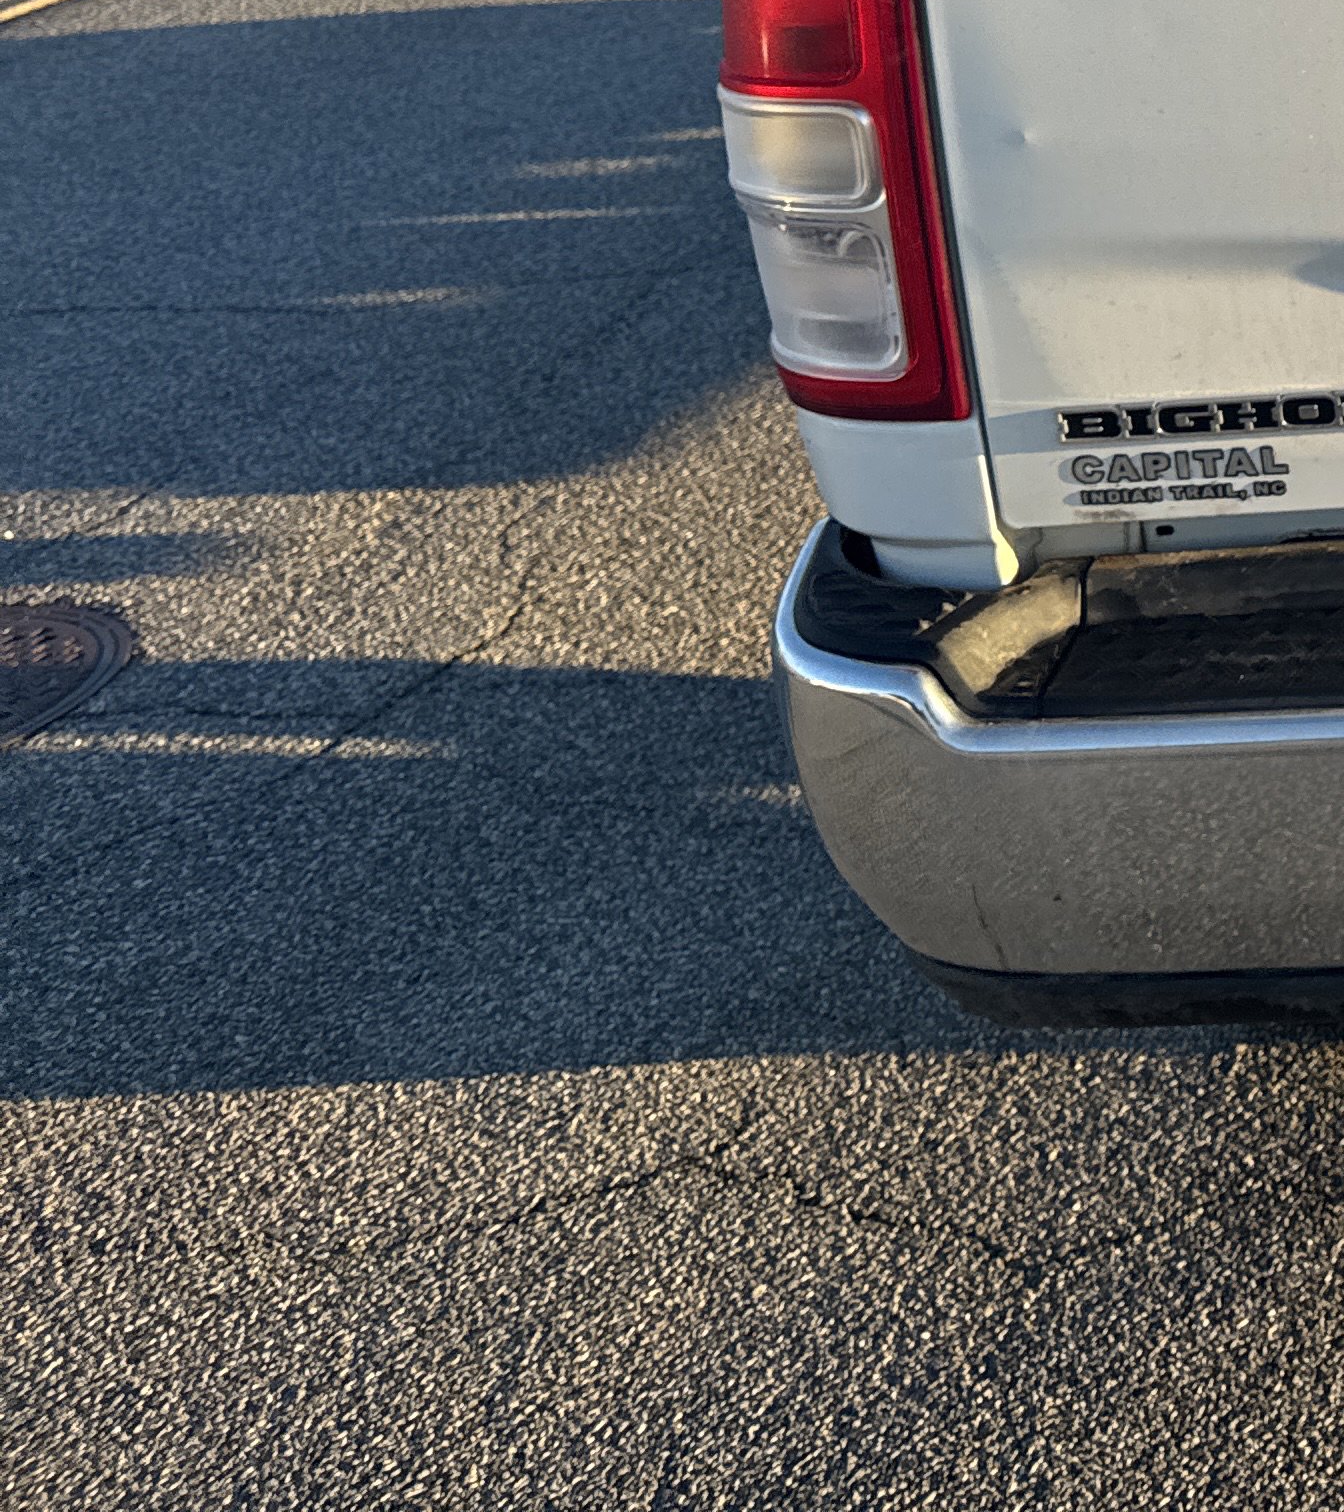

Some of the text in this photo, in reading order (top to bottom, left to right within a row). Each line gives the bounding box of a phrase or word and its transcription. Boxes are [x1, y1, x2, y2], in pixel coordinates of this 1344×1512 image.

[1071, 445, 1289, 485] CAPITAL
[1080, 479, 1288, 505] INDIAN TRAIL, NC
